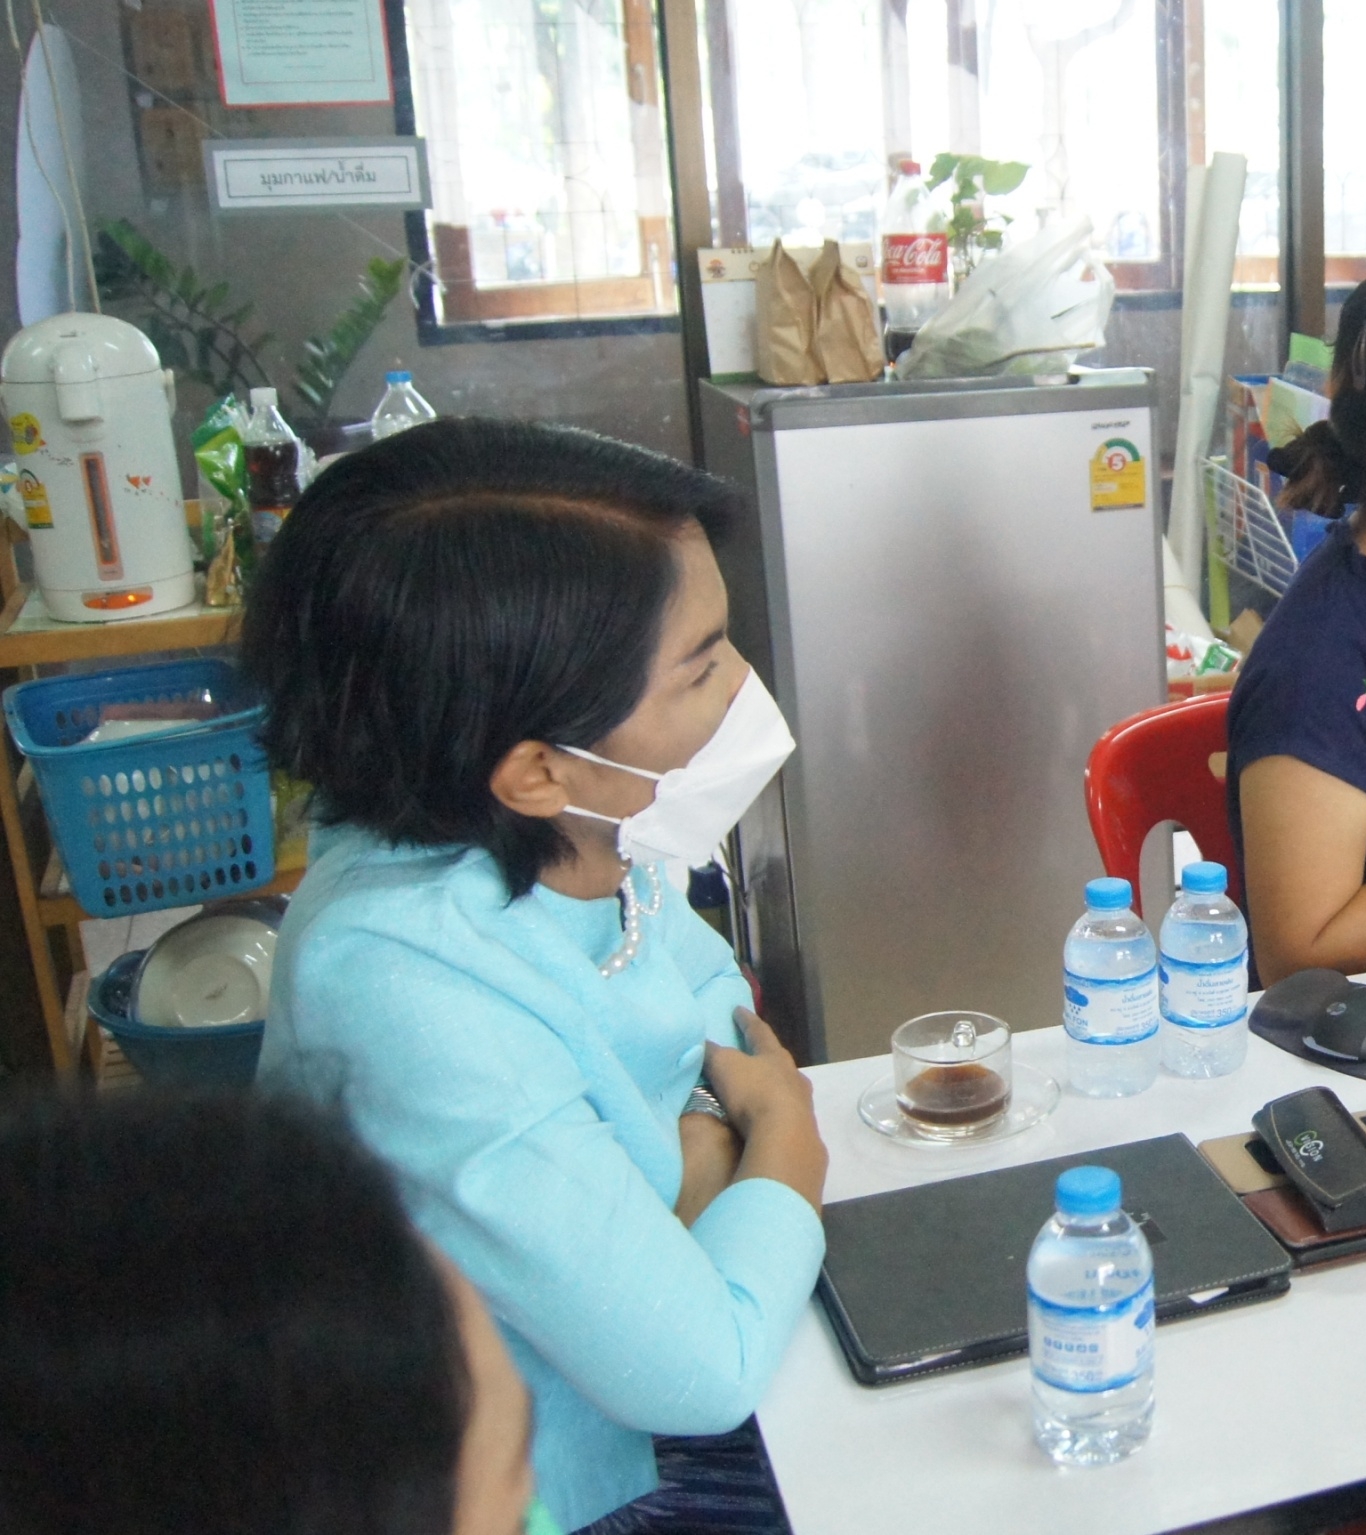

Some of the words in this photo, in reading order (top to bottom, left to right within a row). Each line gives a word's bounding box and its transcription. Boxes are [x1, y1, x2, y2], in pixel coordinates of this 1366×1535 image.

[260, 160, 376, 191] มุมกาแฟ/น้ำดื่ม
[1216, 1007, 1232, 1018] 350
